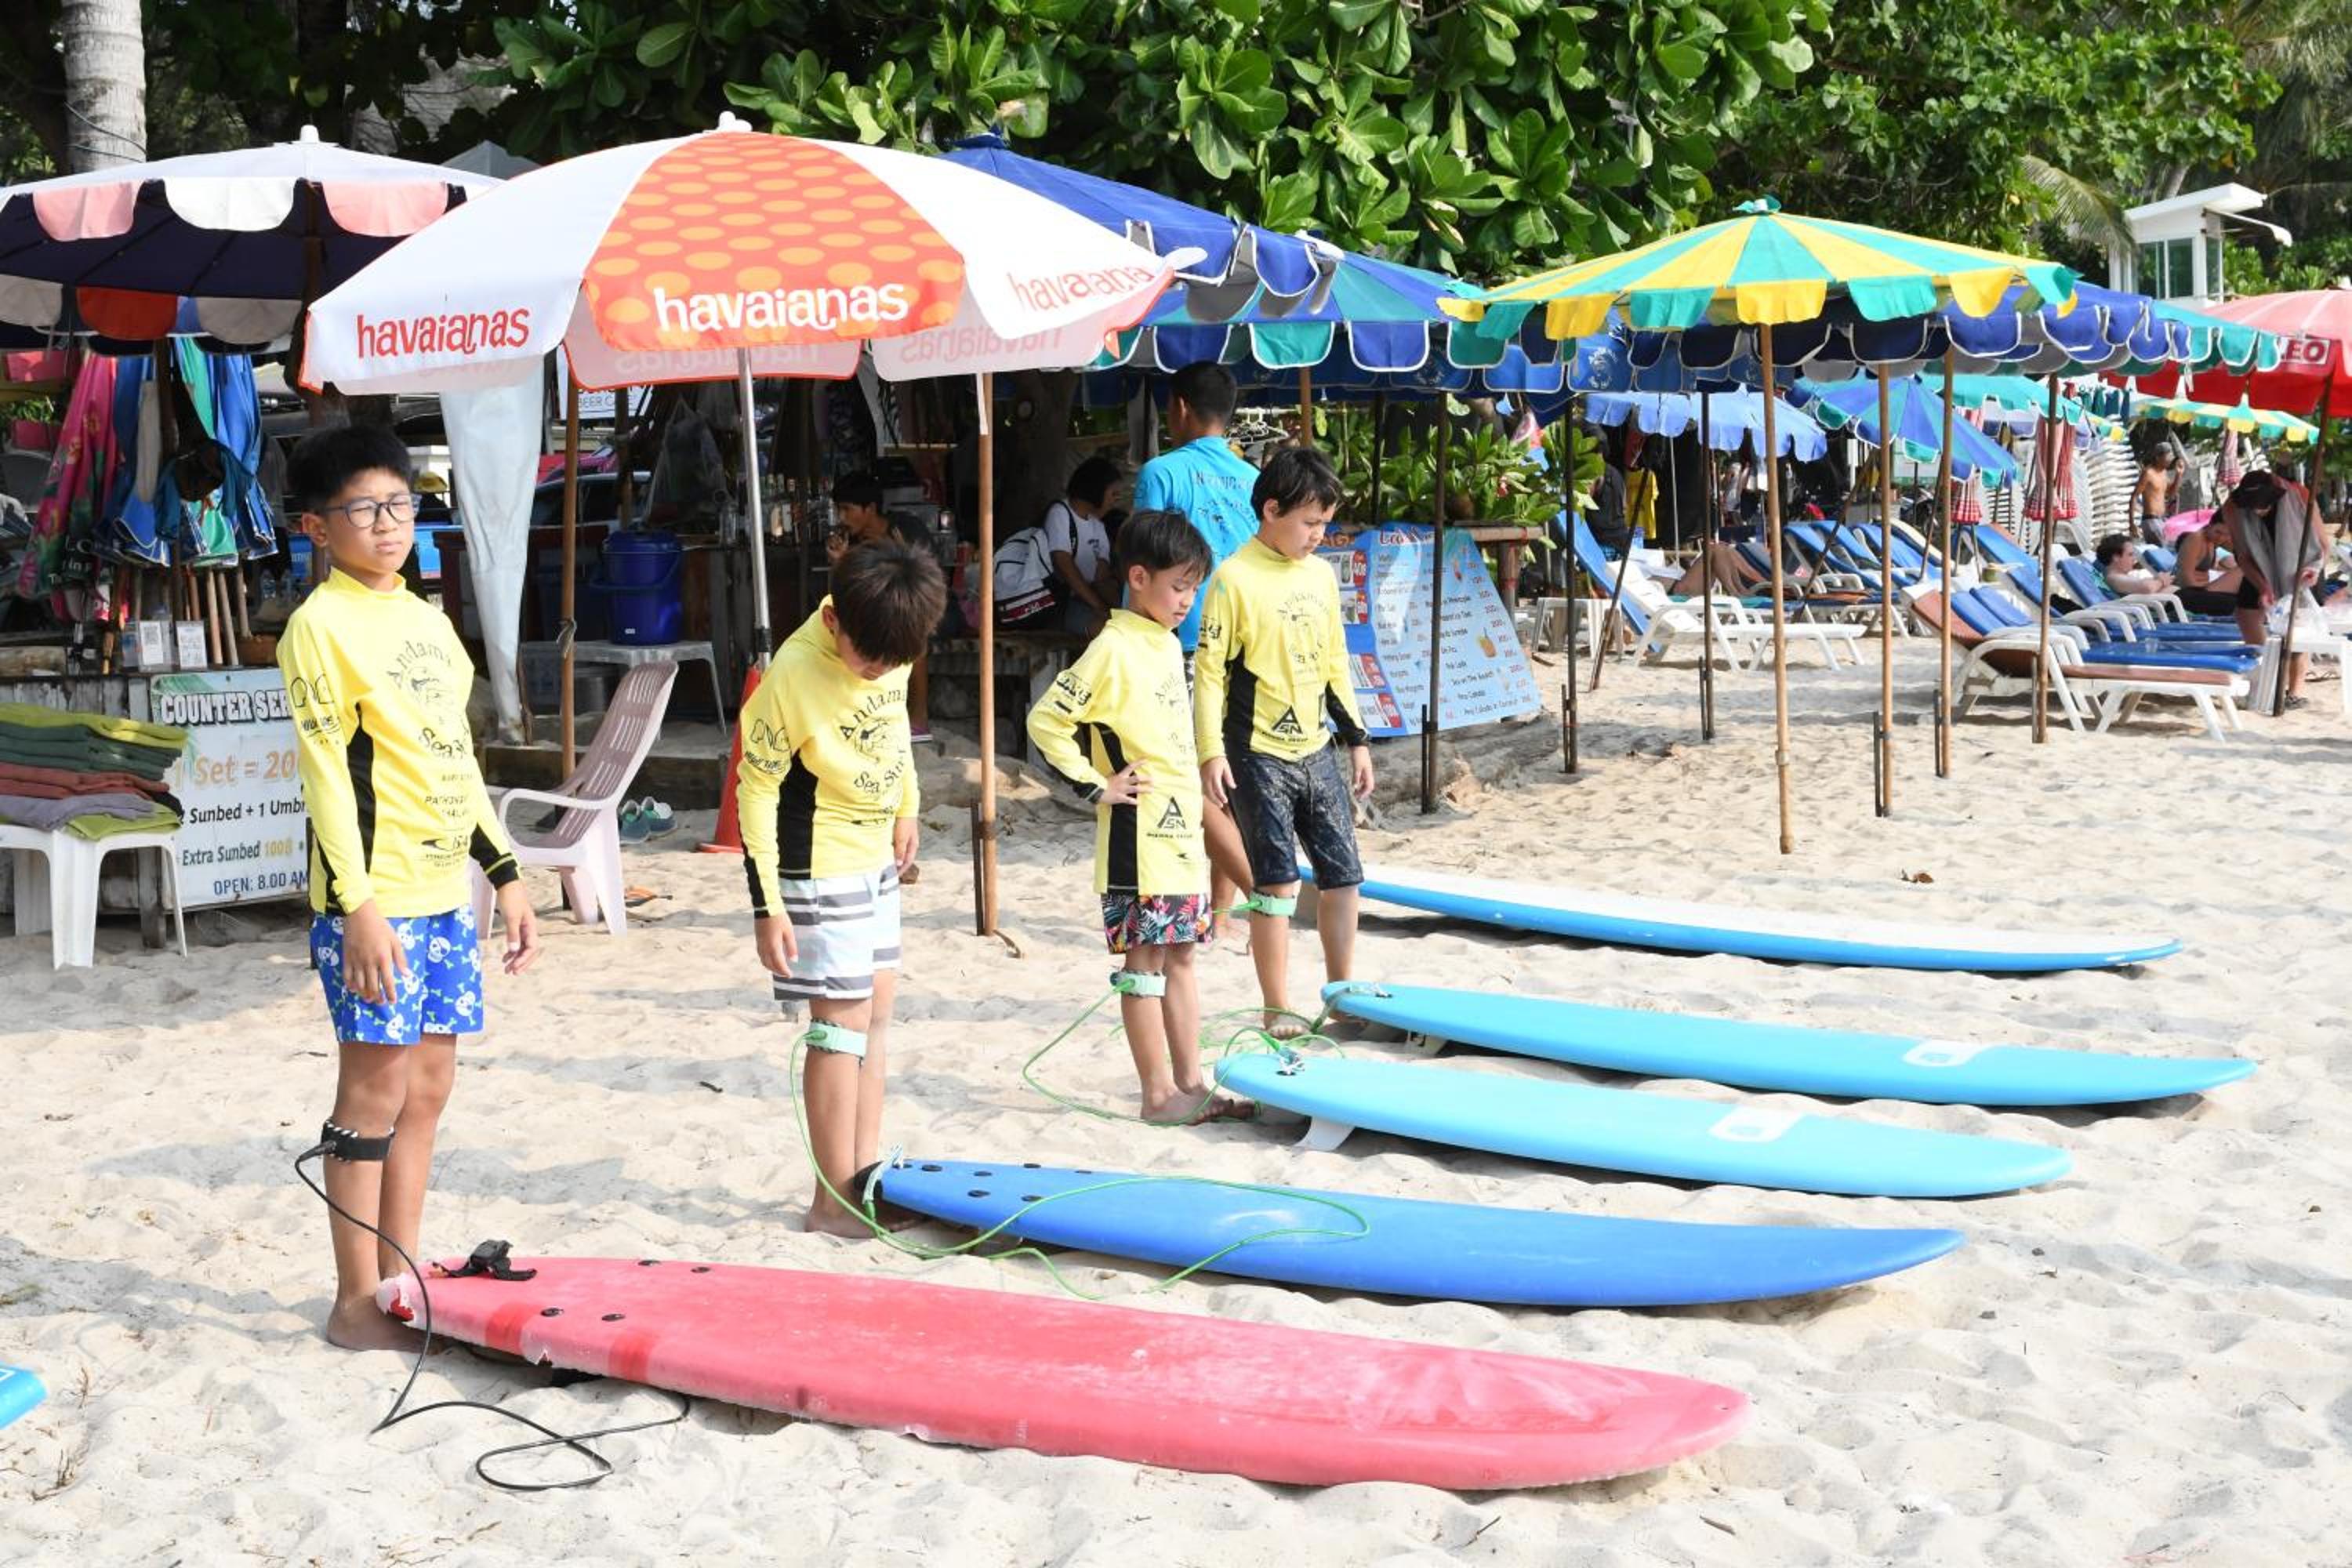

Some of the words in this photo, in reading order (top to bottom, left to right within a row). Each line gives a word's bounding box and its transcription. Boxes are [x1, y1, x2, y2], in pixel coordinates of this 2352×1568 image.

[653, 283, 909, 331] havaianas
[357, 308, 530, 358] havaianas
[2280, 339, 2326, 362] EO
[161, 691, 255, 726] COUNTER
[195, 751, 238, 786] Set
[190, 802, 242, 824] Sunbed
[245, 805, 254, 816] +
[259, 802, 265, 817] 1
[183, 847, 213, 866] Extra
[217, 840, 261, 863] Sunbed
[214, 877, 254, 896] OPEN:
[258, 872, 286, 890] 8.00
